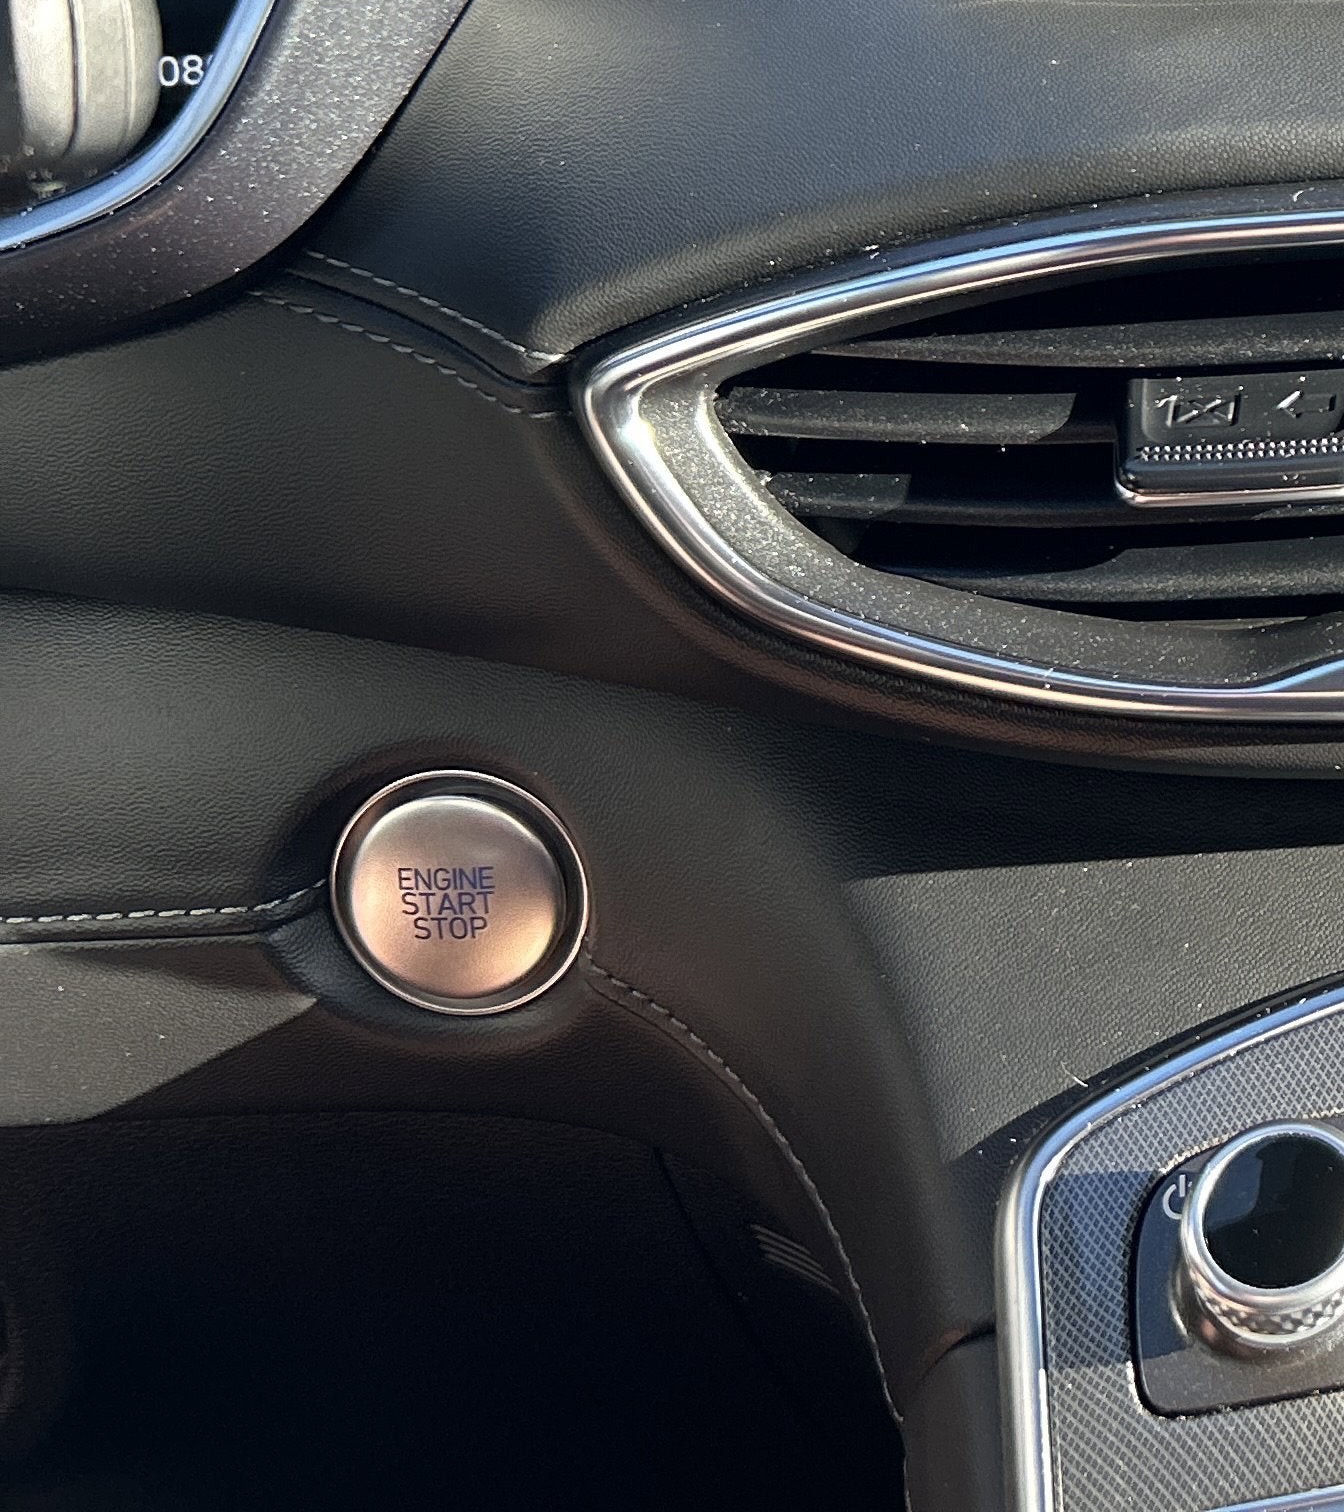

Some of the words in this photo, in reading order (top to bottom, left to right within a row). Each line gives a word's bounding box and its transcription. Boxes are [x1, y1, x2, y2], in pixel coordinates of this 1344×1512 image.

[158, 54, 213, 87] 08
[397, 866, 496, 891] ENGINE
[401, 890, 495, 916] START
[412, 915, 489, 940] STOP
